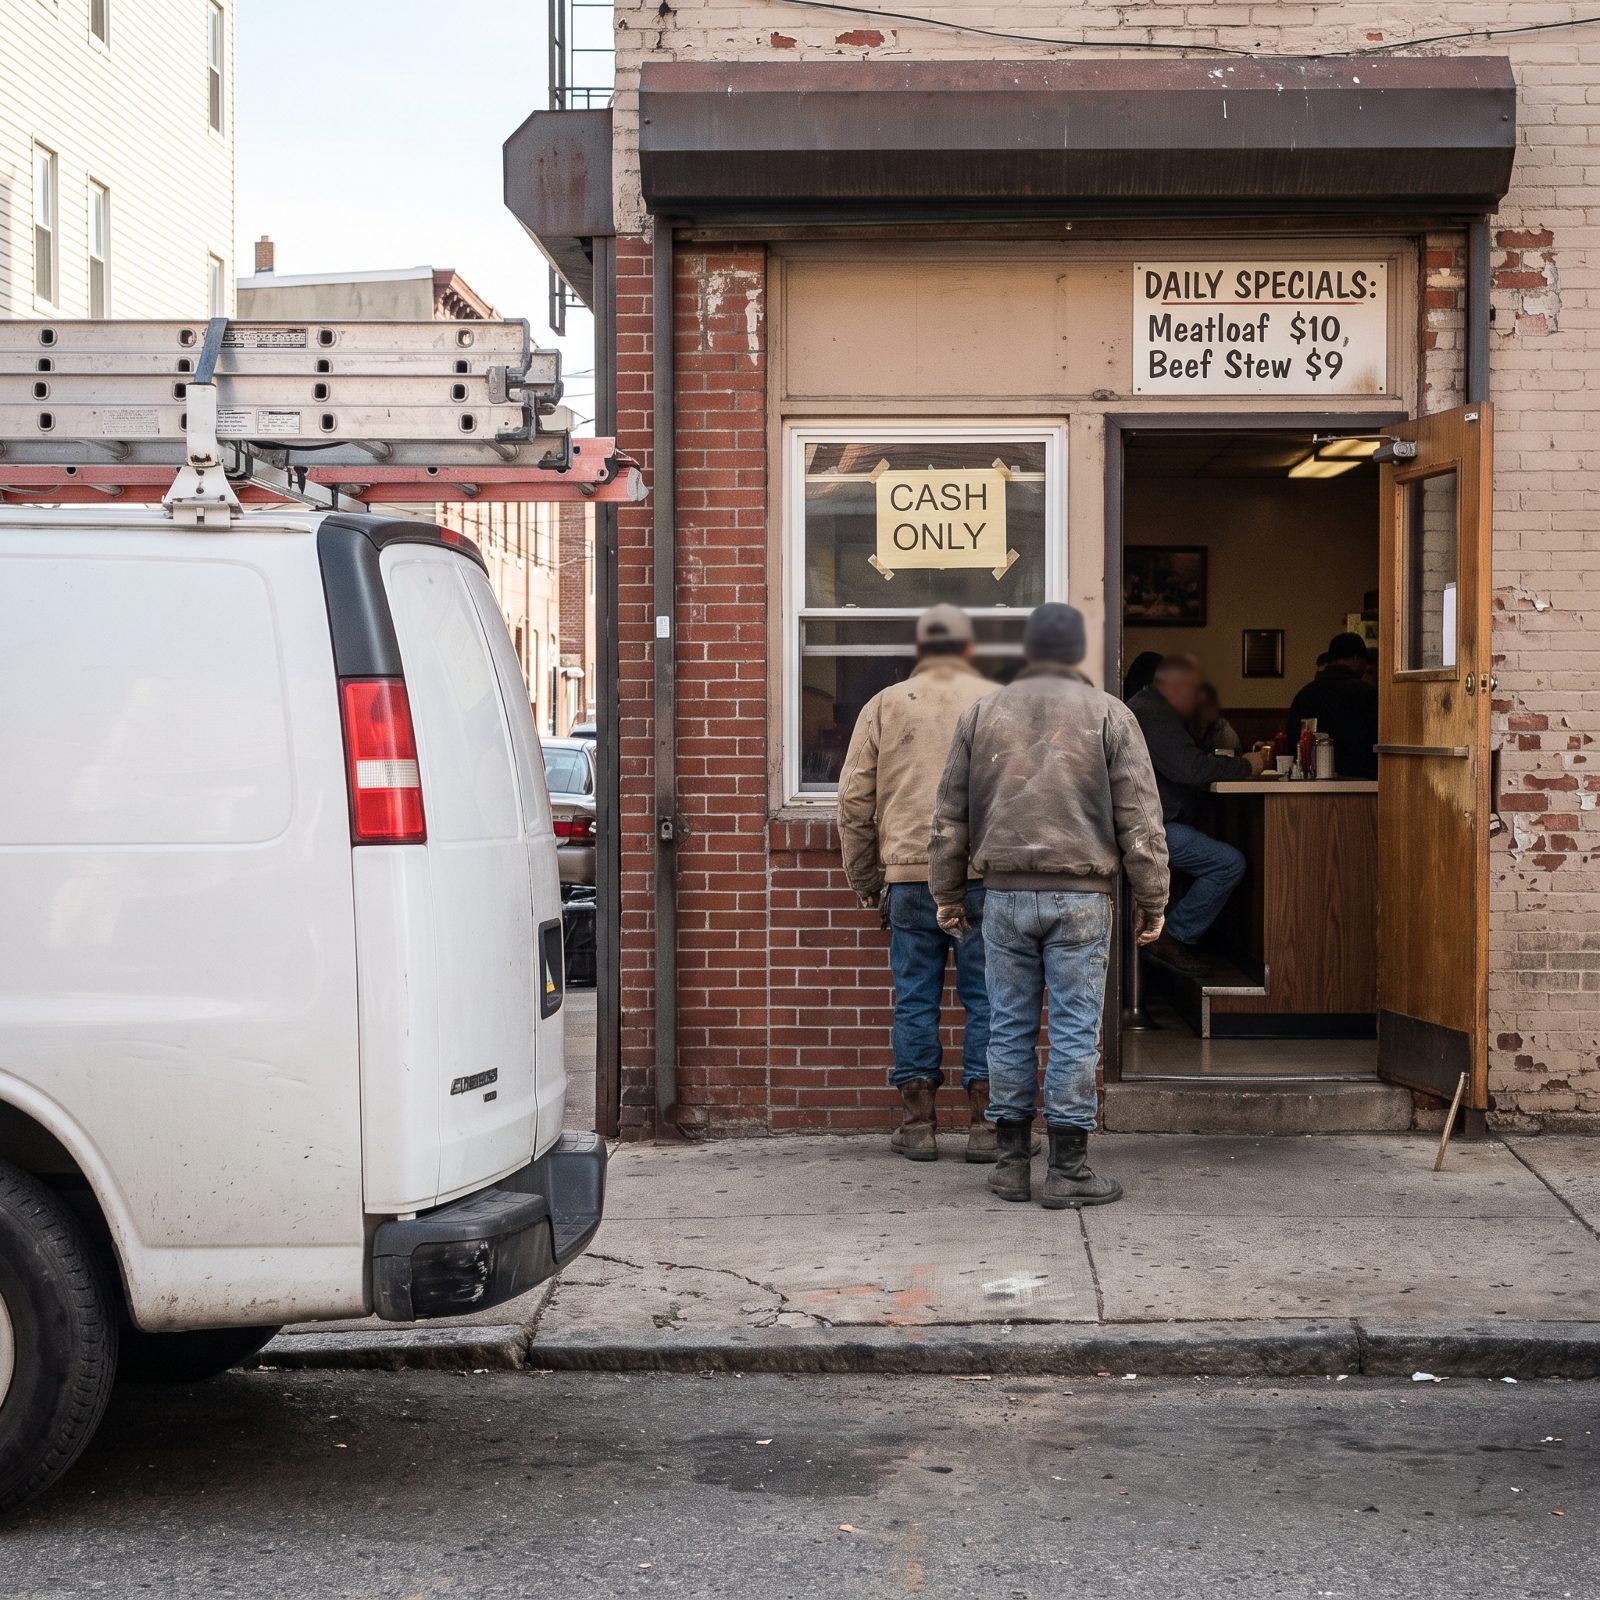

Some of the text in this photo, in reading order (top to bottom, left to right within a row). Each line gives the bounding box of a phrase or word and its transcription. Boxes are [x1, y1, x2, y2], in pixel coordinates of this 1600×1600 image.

[1146, 270, 1376, 300] DAILY SPECIALS:
[1150, 313, 1269, 342] Meatloaf
[1150, 347, 1342, 381] Beef Stew $9
[891, 484, 986, 511] CASH
[894, 523, 986, 550] ONLY
